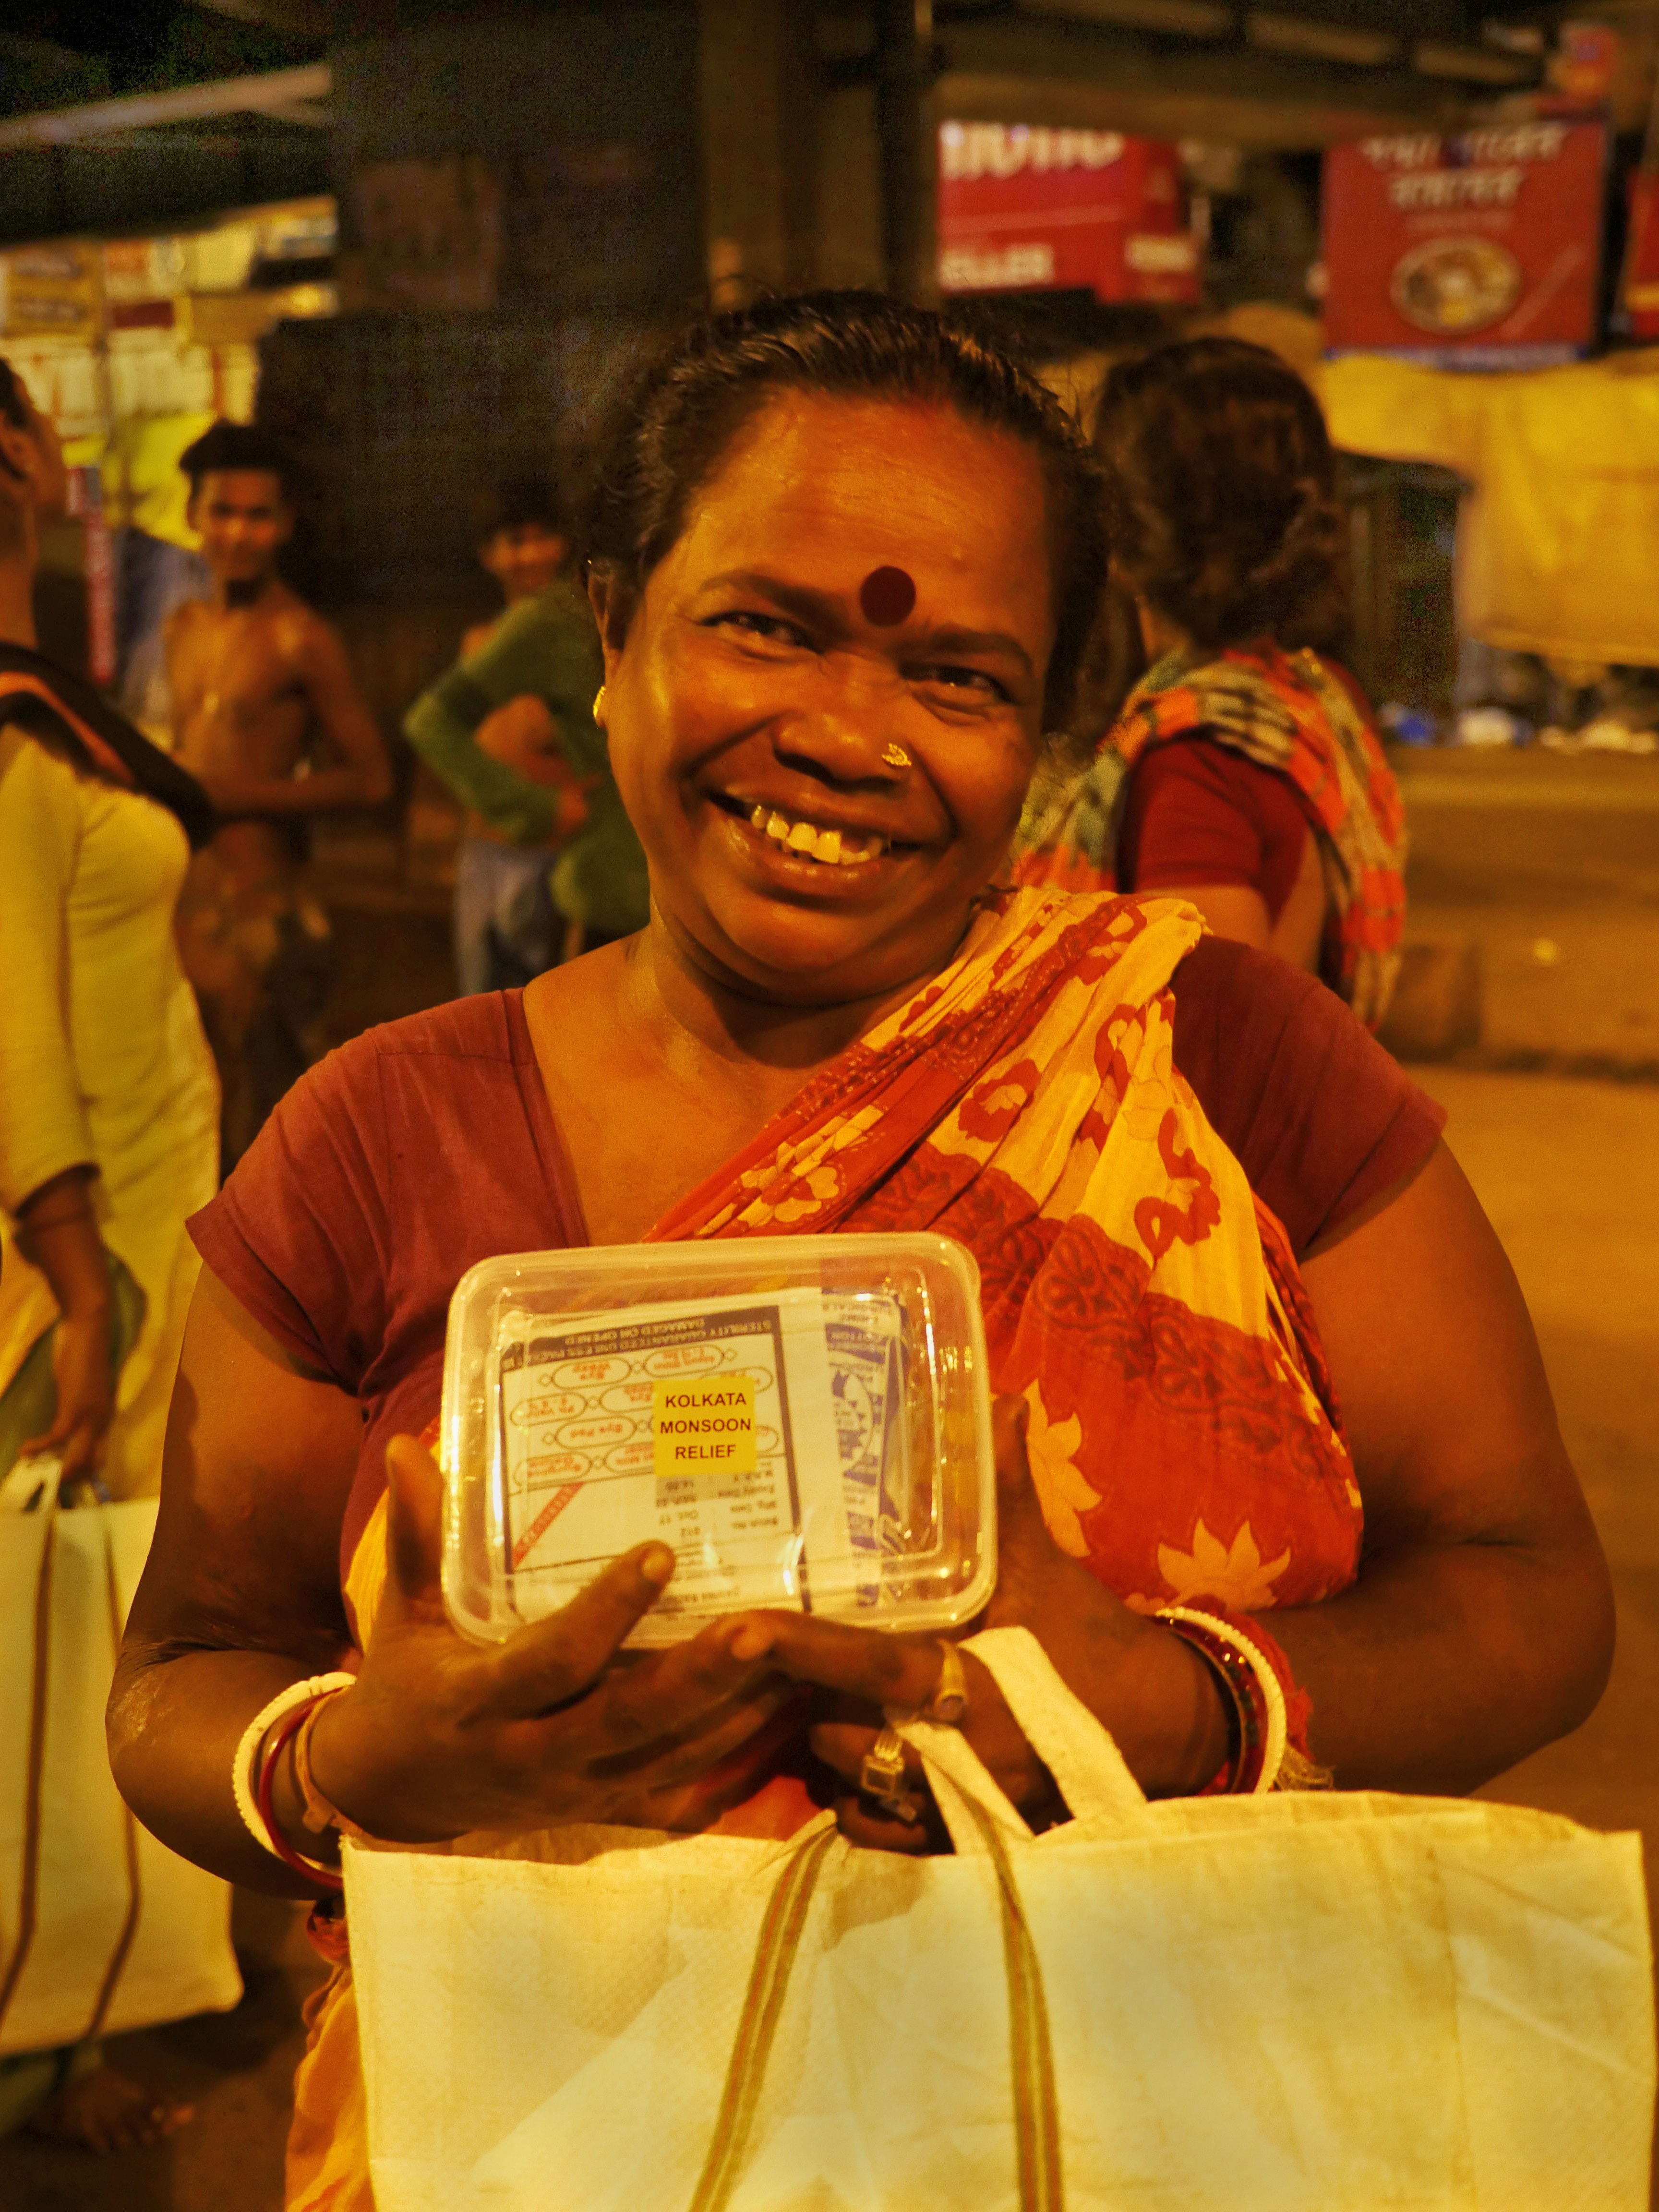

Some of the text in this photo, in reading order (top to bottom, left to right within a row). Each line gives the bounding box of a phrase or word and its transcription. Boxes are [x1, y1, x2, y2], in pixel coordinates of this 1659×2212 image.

[665, 1392, 747, 1408] KOLKATA
[660, 1418, 752, 1434] MONSOON
[675, 1444, 736, 1460] RELIEF
